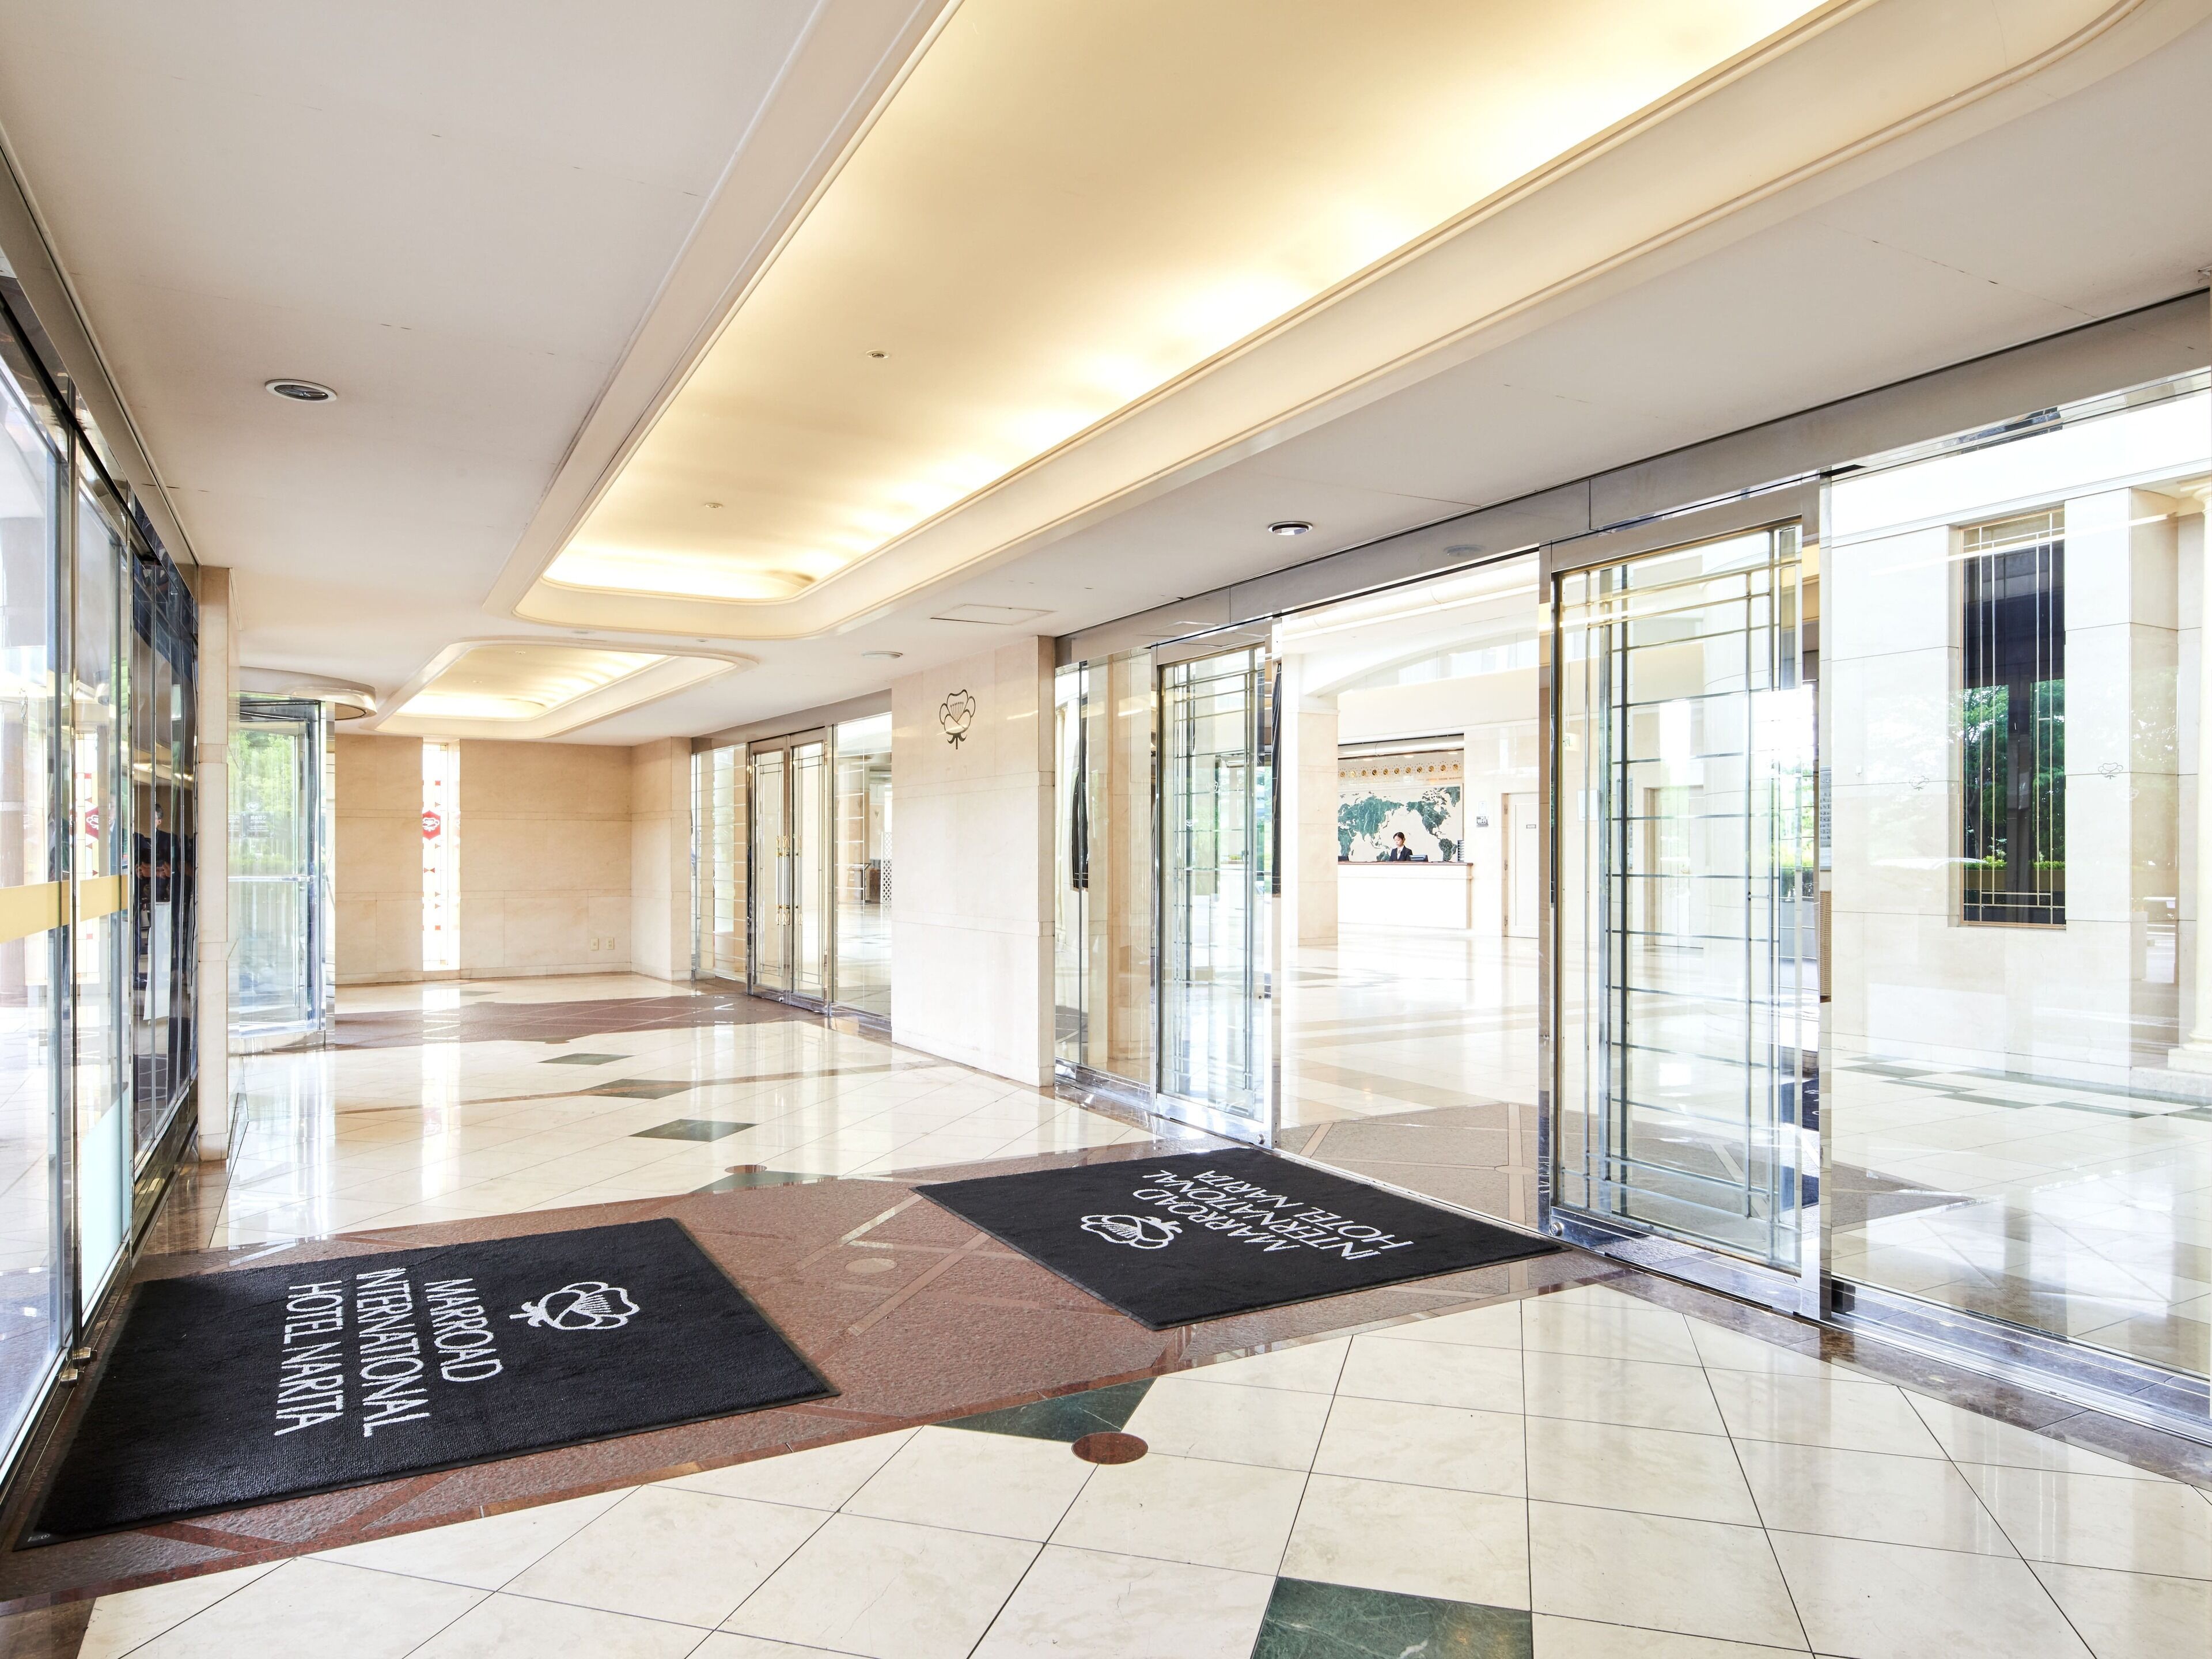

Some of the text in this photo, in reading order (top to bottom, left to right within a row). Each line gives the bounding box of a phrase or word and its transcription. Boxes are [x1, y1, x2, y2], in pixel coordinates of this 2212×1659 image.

[1133, 1189, 1300, 1251] MARROAD
[1142, 1170, 1381, 1260] INTERNATIONAL
[1194, 1171, 1414, 1249] HOTEL NARITA
[274, 1280, 344, 1435] HOTEL NARITA
[356, 1268, 430, 1437] INTERNATIONAL
[424, 1278, 503, 1381] MARROAD
